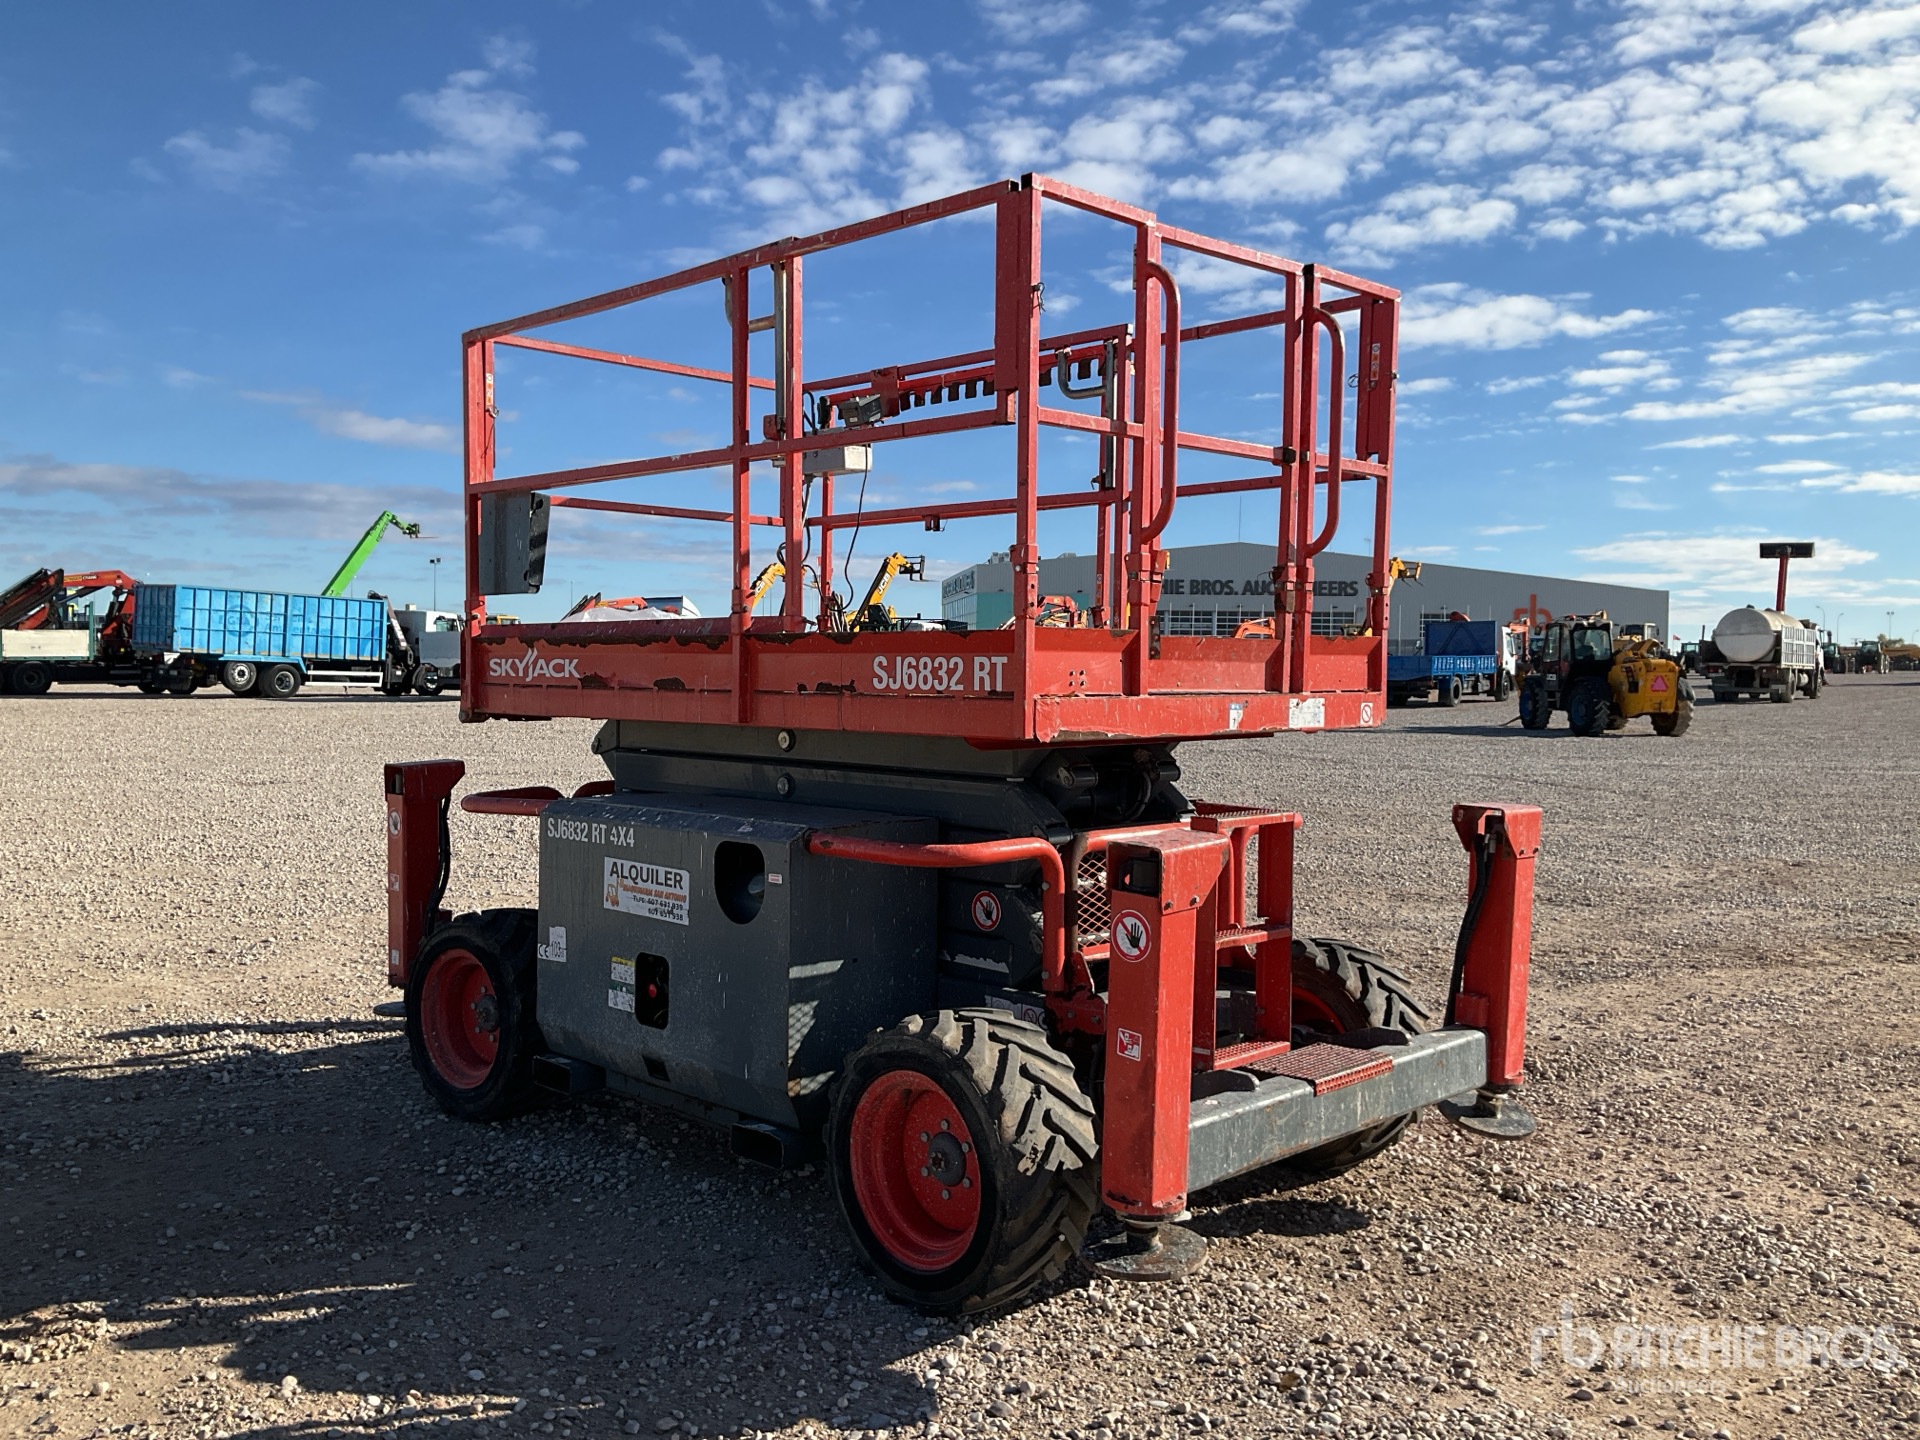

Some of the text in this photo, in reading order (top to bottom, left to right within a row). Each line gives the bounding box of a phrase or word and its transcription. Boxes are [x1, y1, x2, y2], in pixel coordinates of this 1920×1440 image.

[1189, 579, 1238, 595] BROS.
[489, 647, 580, 682] SKYJACK
[872, 655, 1008, 691] SJ6832 RT
[547, 817, 635, 847] SJ6832 RT 4X4
[610, 861, 683, 890] ALQUILER
